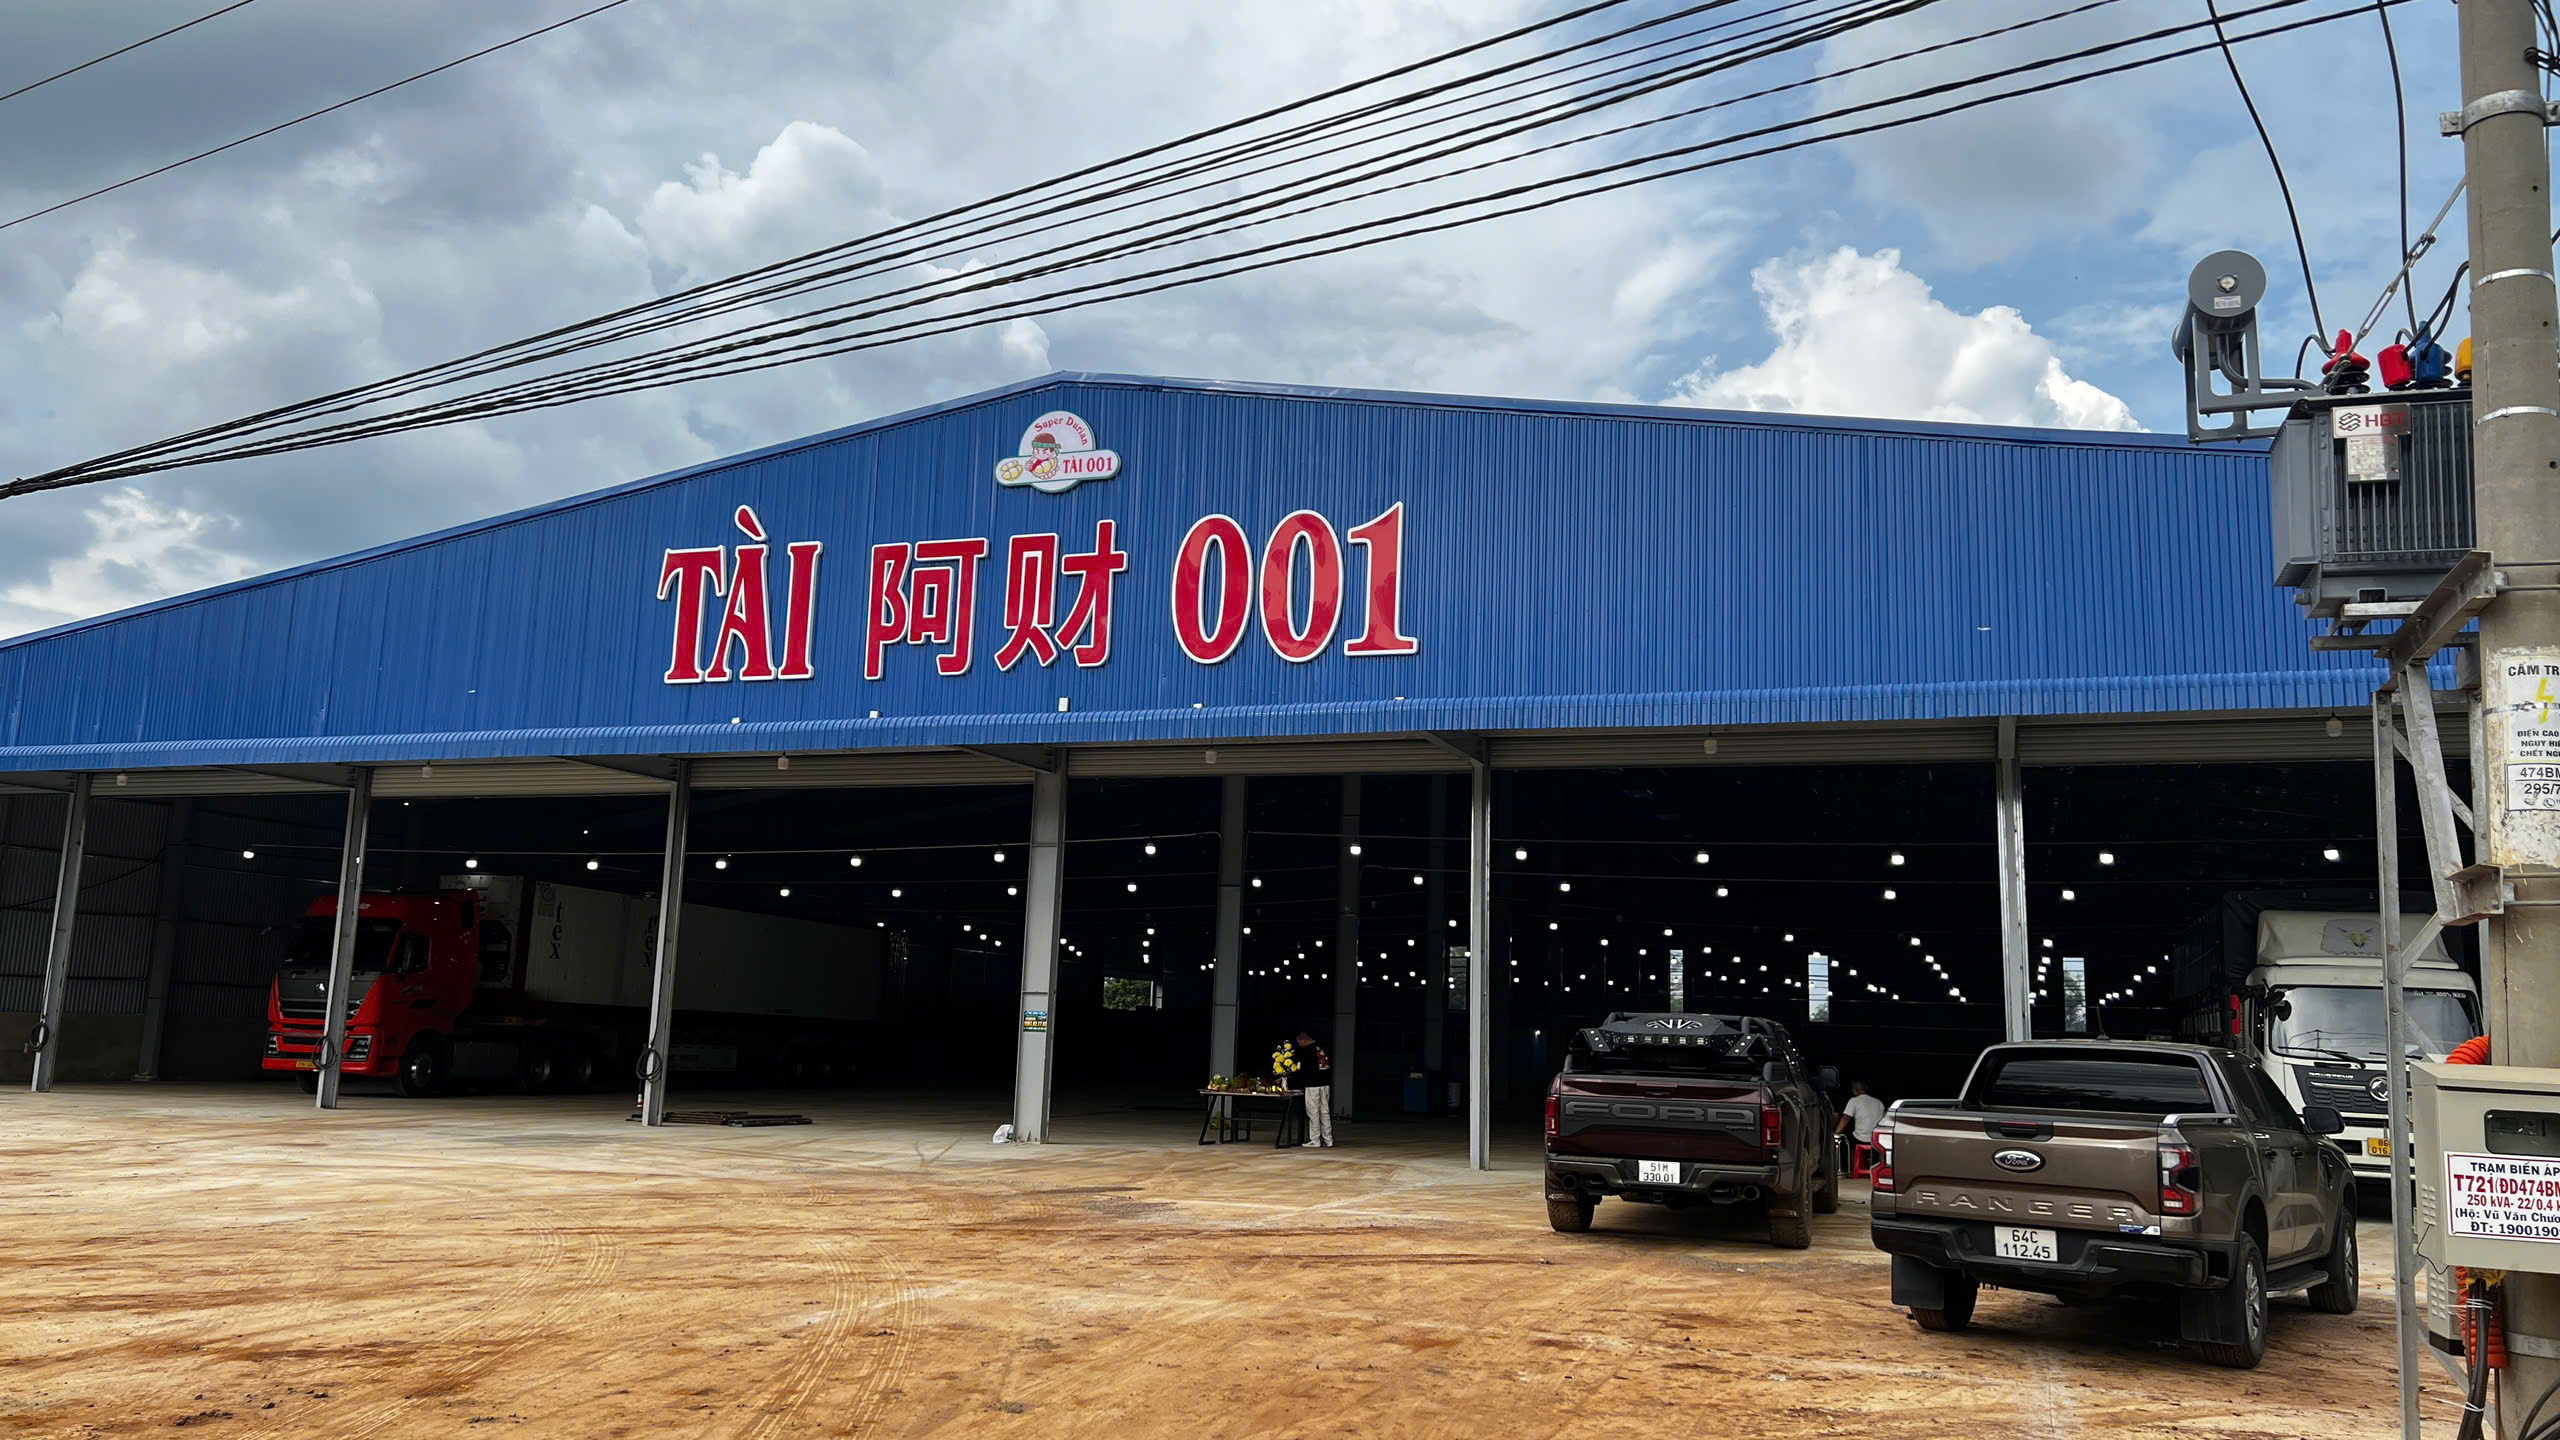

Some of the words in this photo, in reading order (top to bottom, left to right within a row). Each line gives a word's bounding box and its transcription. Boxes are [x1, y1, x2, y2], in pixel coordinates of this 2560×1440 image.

[2365, 412, 2408, 428] HBT
[1034, 417, 1064, 432] Super
[1065, 416, 1088, 446] Durian
[1063, 455, 1082, 474] TÀI
[1086, 456, 1113, 473] 001
[657, 505, 823, 684] TÀI
[865, 520, 1128, 680] 阿财
[1171, 501, 1419, 664] 001
[2542, 729, 2560, 738] CAO
[1565, 1101, 1755, 1124] FORD
[2004, 1153, 2031, 1167] Ford
[2470, 1162, 2506, 1176] TRẠM
[2510, 1161, 2540, 1175] BIẾN
[1643, 1172, 1674, 1183] 330.01
[1916, 1190, 2135, 1222] RANGER
[2467, 1193, 2487, 1207] 250
[2455, 1207, 2480, 1220] (Hộ:
[2484, 1209, 2500, 1219] Vũ
[2504, 1211, 2527, 1221] Văn
[2012, 1229, 2039, 1243] 64C
[2470, 1221, 2493, 1233] ĐT:
[2498, 1223, 2560, 1237] 1900190
[2003, 1243, 2051, 1259] 112.45
